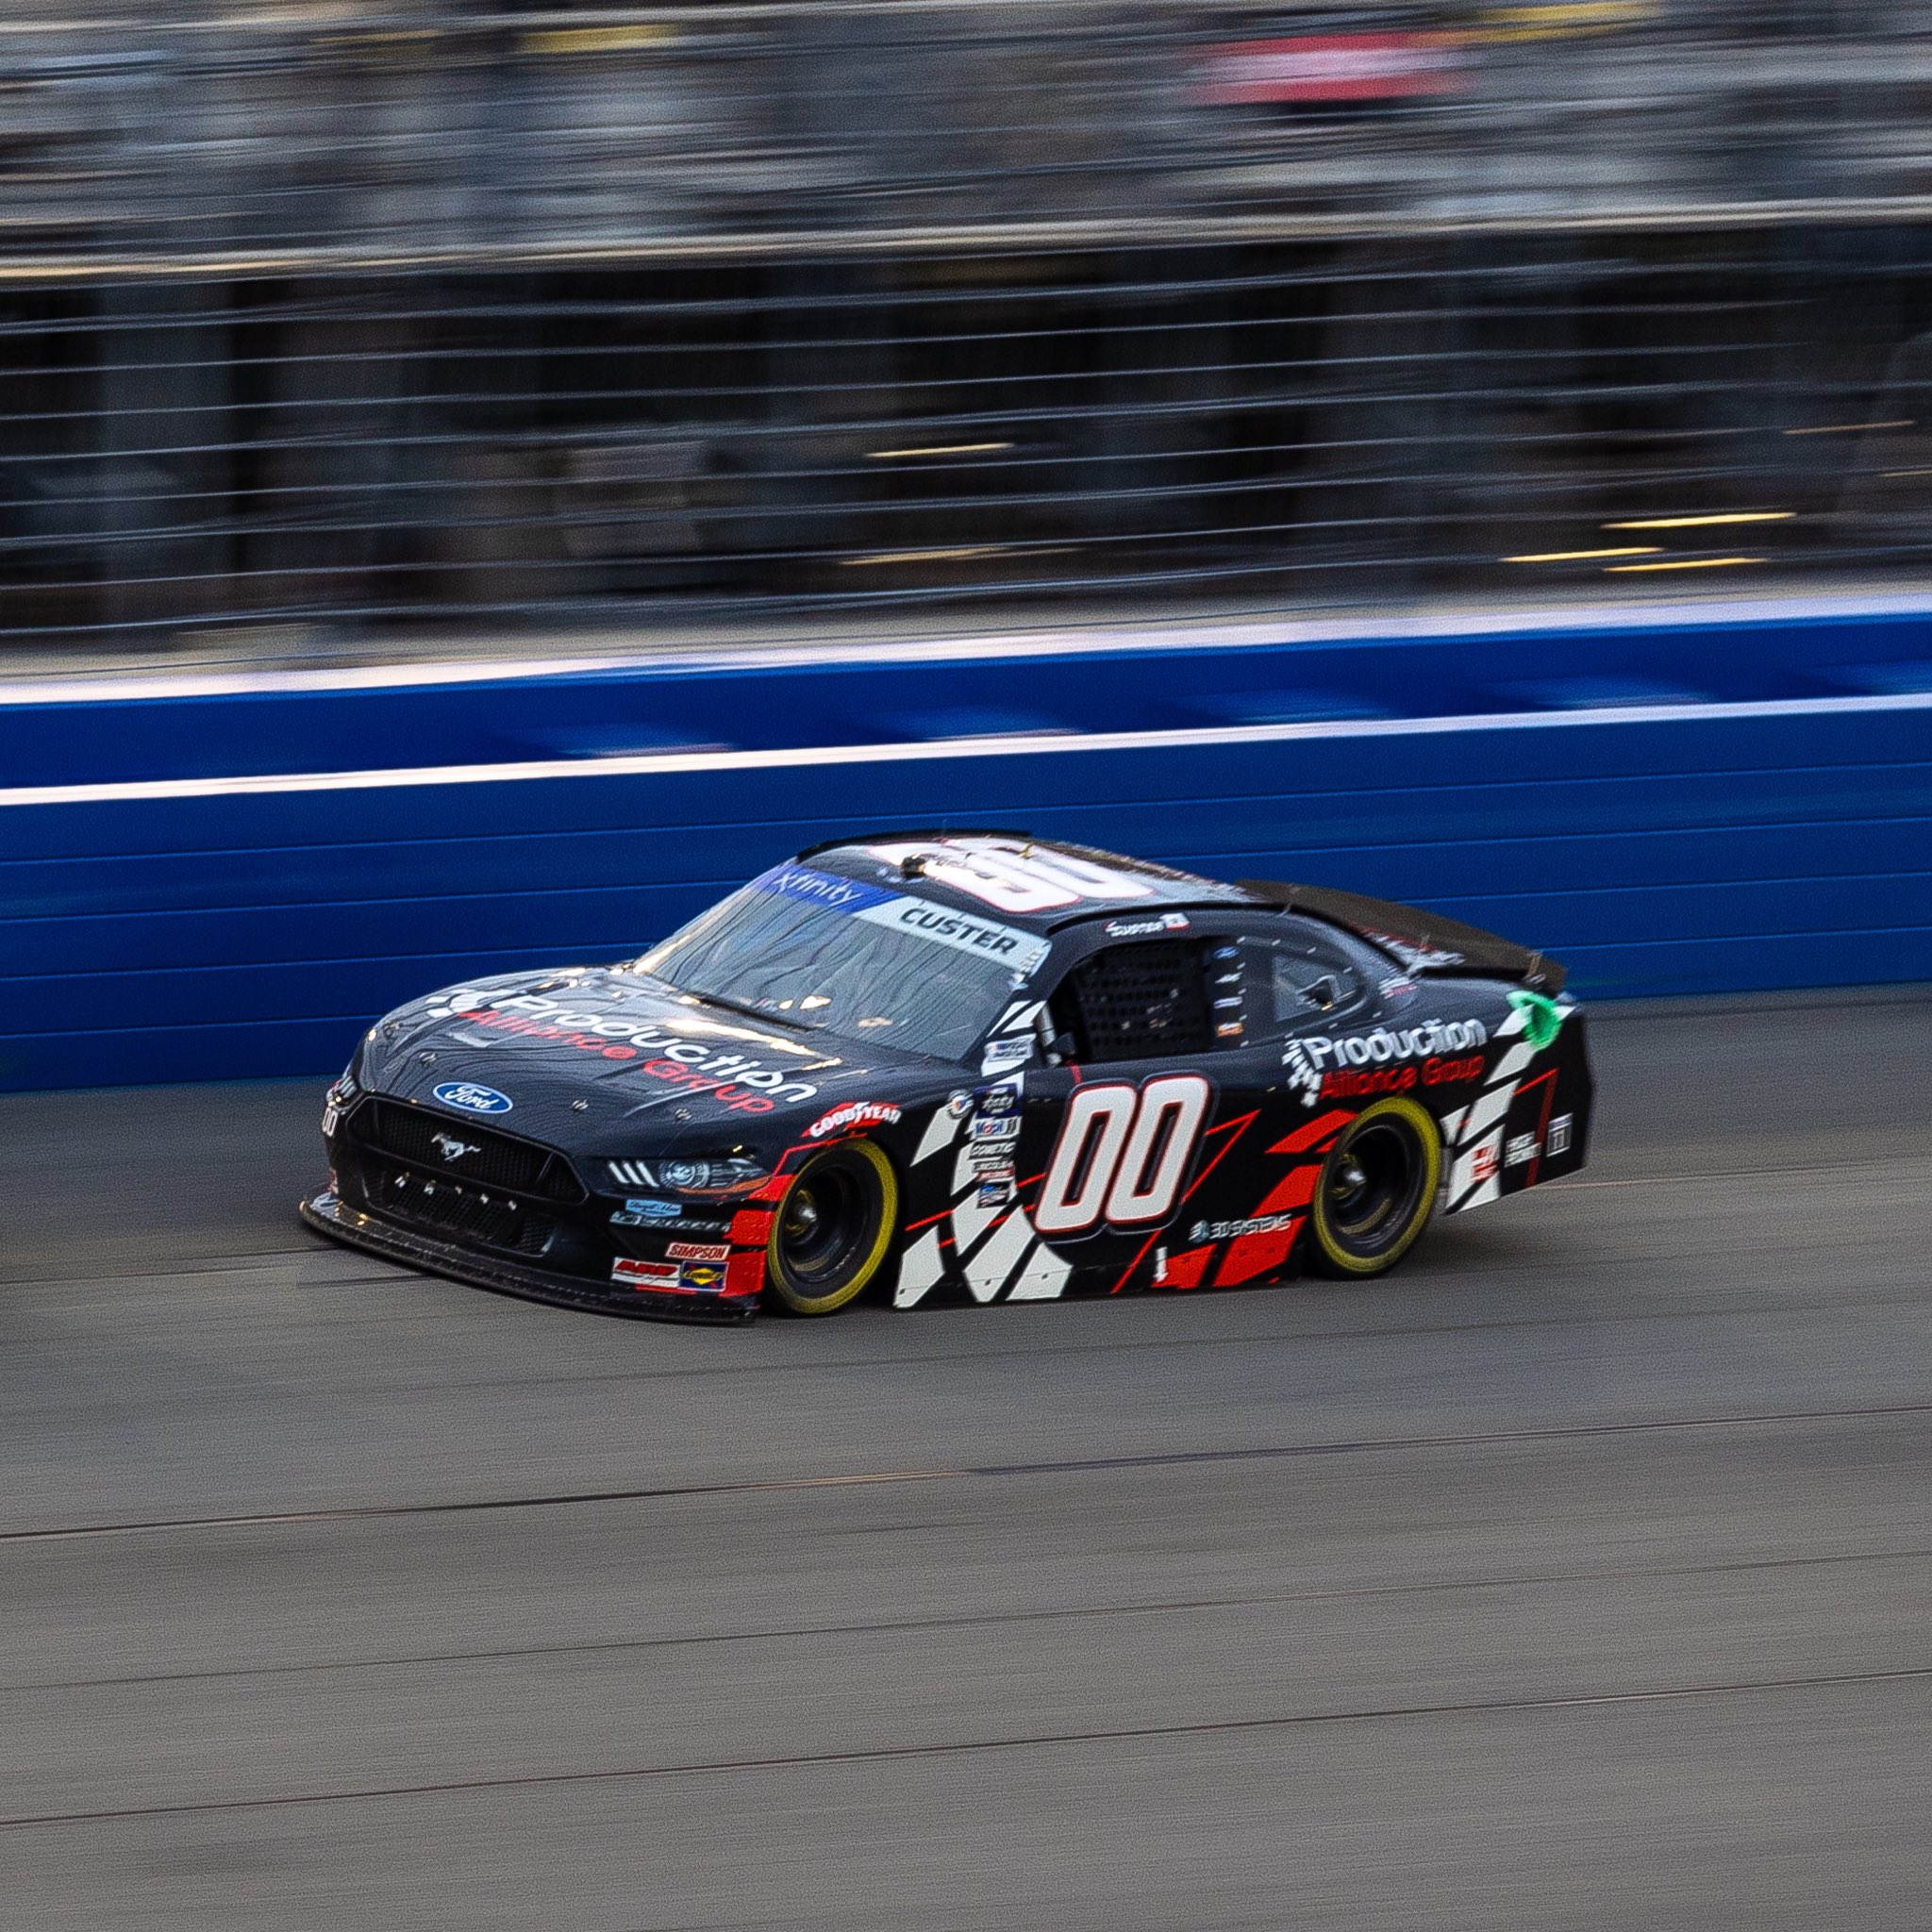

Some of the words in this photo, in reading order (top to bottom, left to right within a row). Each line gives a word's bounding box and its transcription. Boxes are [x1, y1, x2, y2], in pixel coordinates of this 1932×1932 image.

[773, 872, 862, 907] xfinity
[899, 908, 1020, 955] CUSTER
[491, 995, 818, 1104] Production
[1302, 1018, 1488, 1070] Production
[443, 1086, 501, 1109] Ford
[322, 1107, 339, 1138] 00
[810, 1101, 902, 1138] GOODYEAR
[1034, 1074, 1210, 1234] 00
[669, 1244, 726, 1259] SIMPSON
